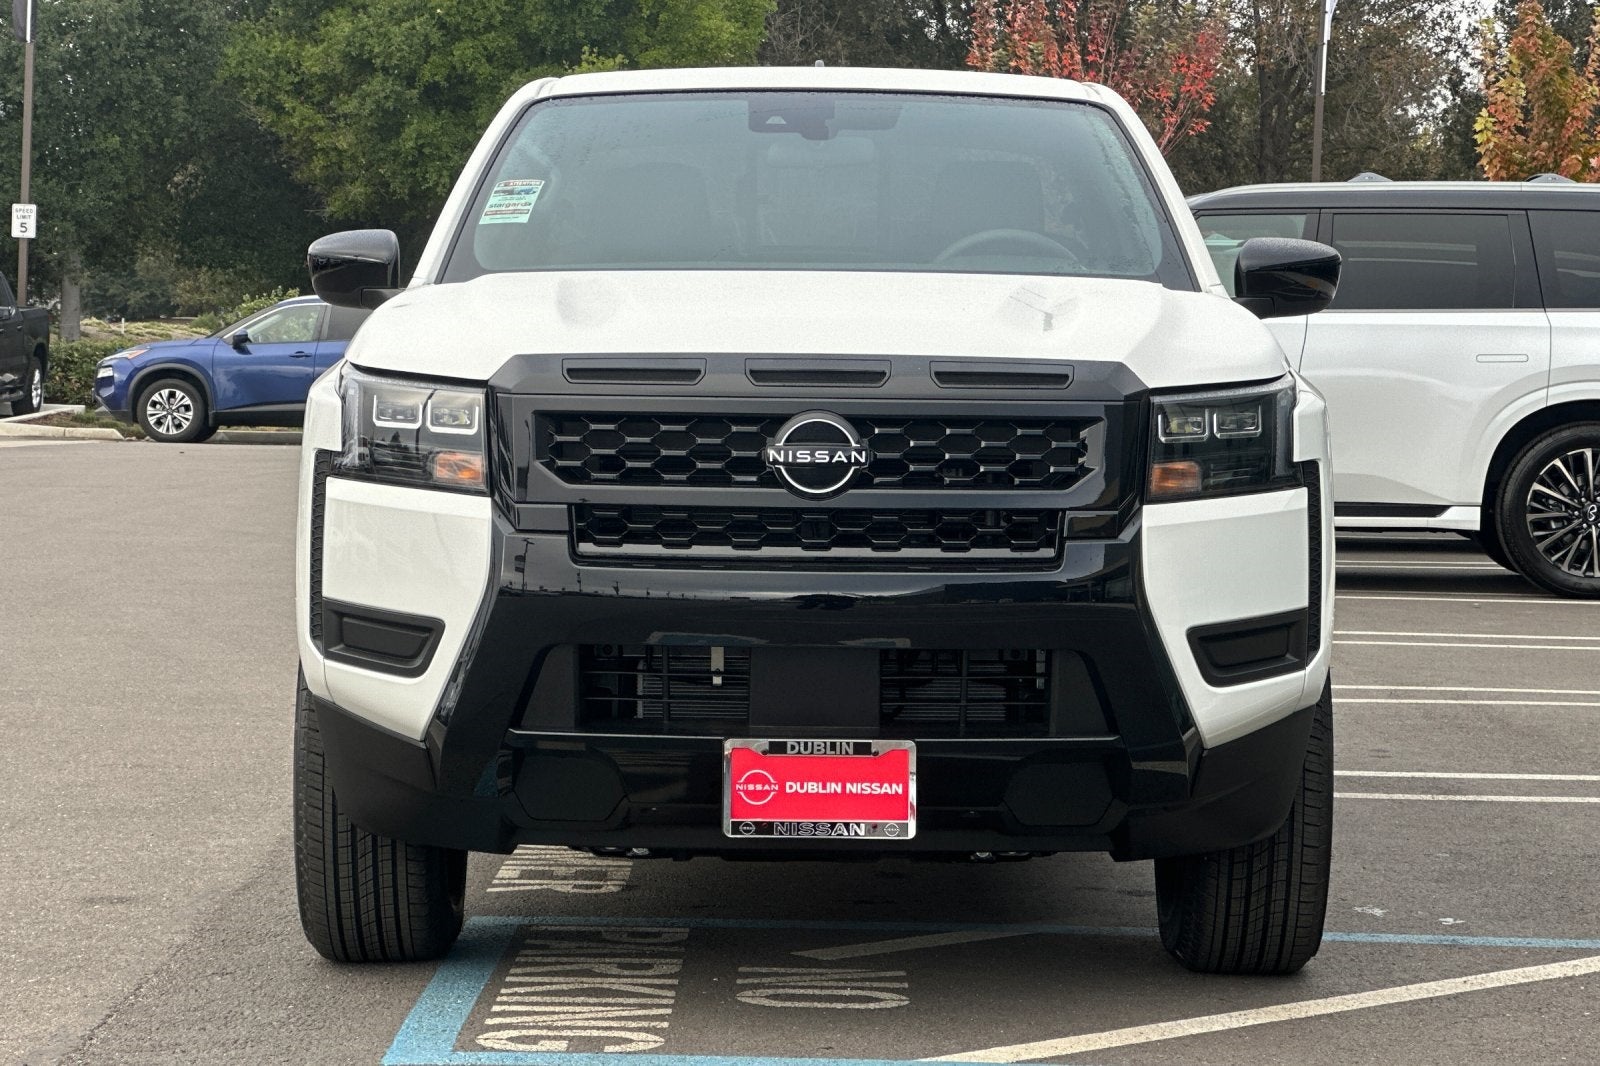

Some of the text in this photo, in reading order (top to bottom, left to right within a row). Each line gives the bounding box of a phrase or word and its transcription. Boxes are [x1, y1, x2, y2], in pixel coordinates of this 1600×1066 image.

[20, 222, 27, 233] 5
[769, 450, 866, 463] NISSAN
[786, 741, 854, 755] DUBLIN
[735, 783, 779, 791] NISSAN
[785, 781, 903, 795] DUBLIN NISSAN
[773, 822, 866, 836] NISSAN
[475, 925, 690, 1053] PARKING
